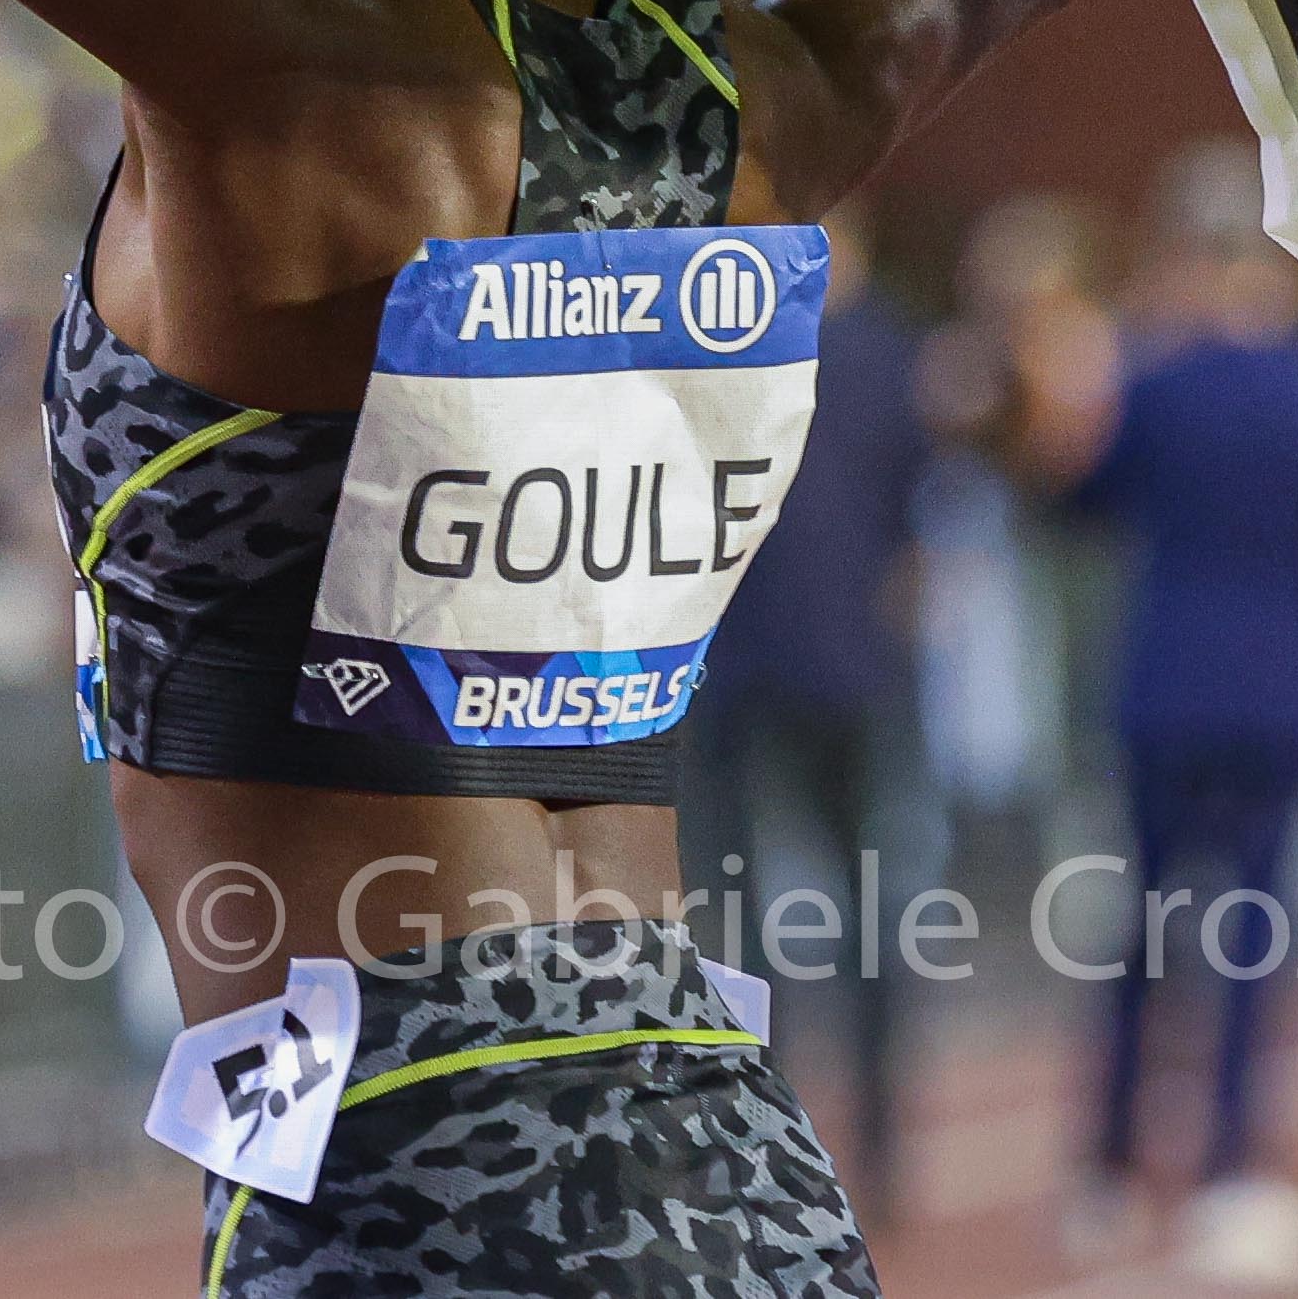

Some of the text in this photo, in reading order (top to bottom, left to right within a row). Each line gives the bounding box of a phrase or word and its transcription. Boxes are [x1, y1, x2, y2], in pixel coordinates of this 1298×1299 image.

[457, 260, 662, 341] Allianz
[400, 457, 772, 583] GOULE
[453, 664, 692, 729] BRUSSELS
